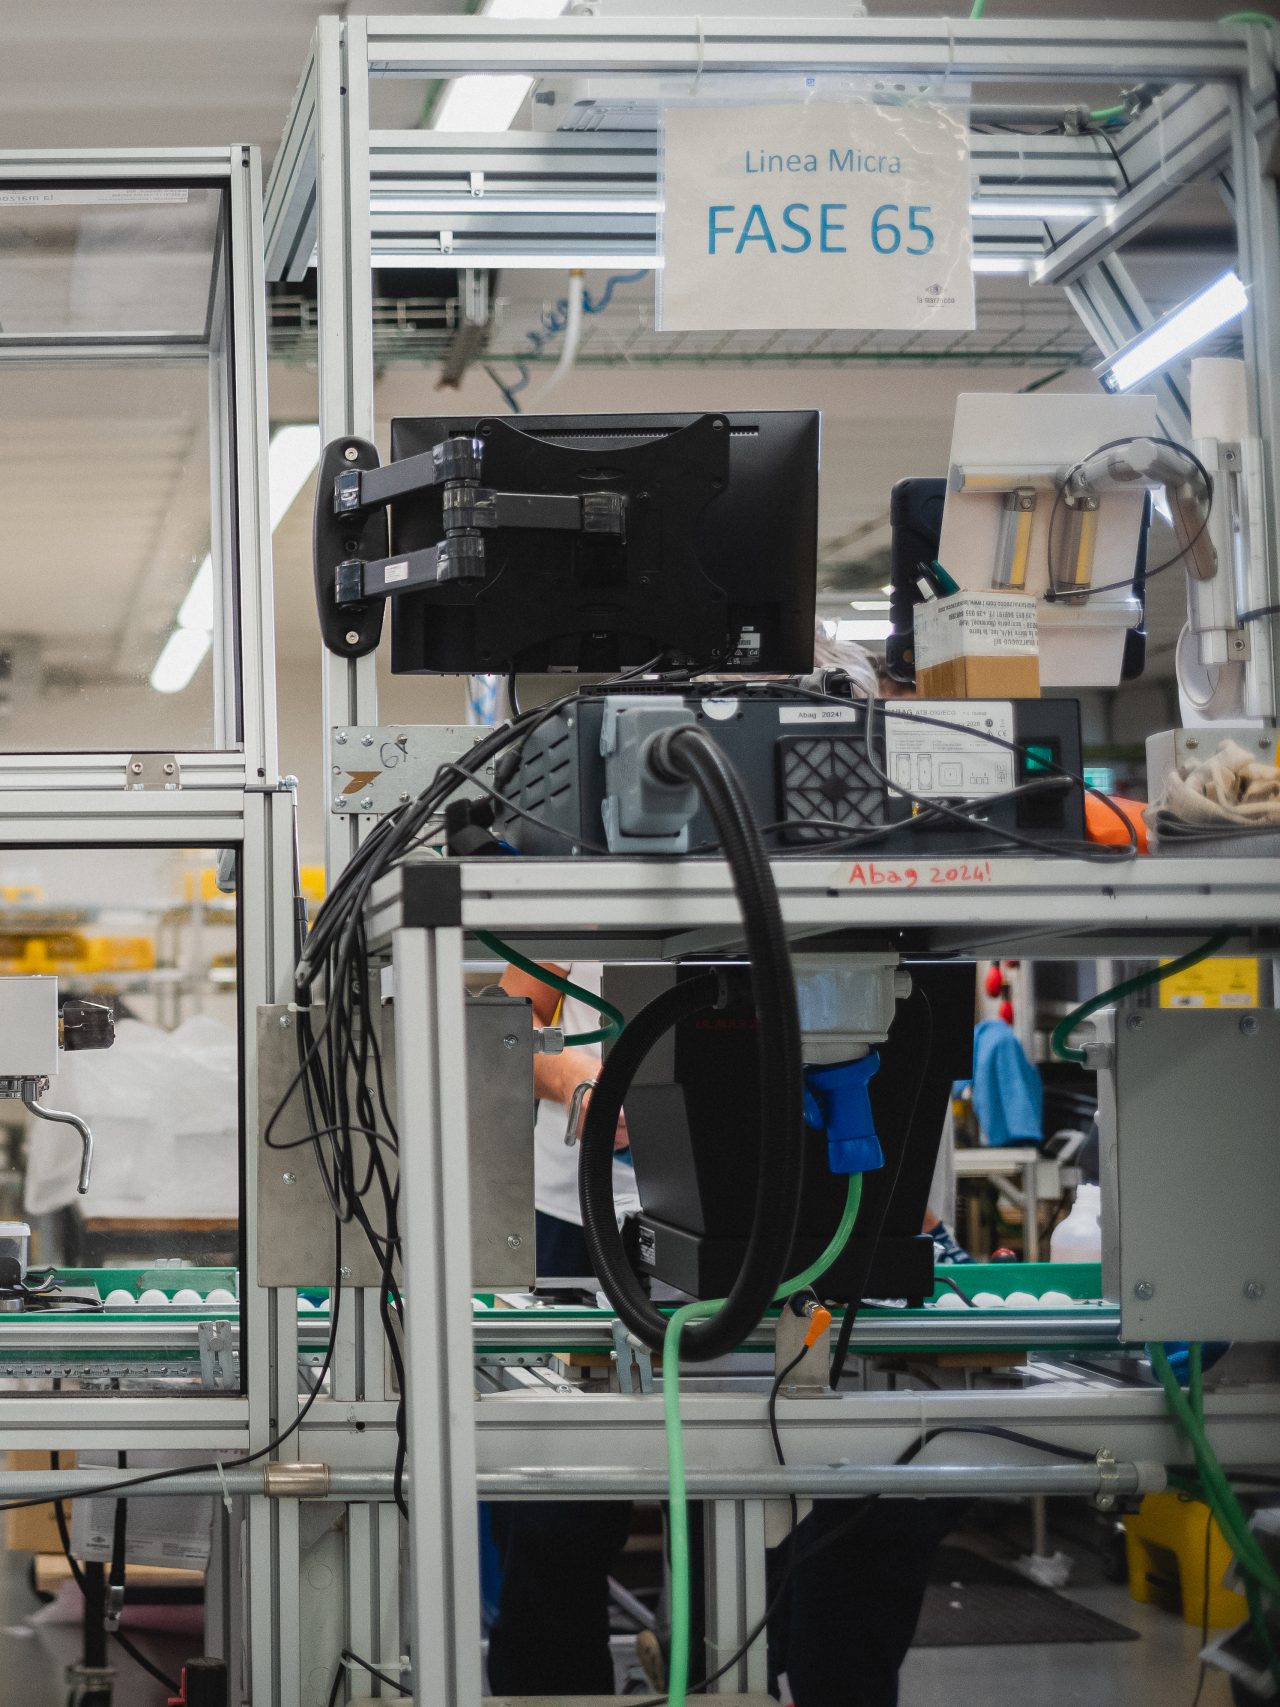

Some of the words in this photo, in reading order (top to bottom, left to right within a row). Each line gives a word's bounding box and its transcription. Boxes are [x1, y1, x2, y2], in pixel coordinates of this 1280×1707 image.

[745, 150, 817, 173] Linea
[829, 149, 901, 174] Micra
[708, 203, 847, 255] FASE
[871, 204, 935, 256] 65
[849, 863, 918, 888] Abag
[930, 862, 991, 883] 2024!
